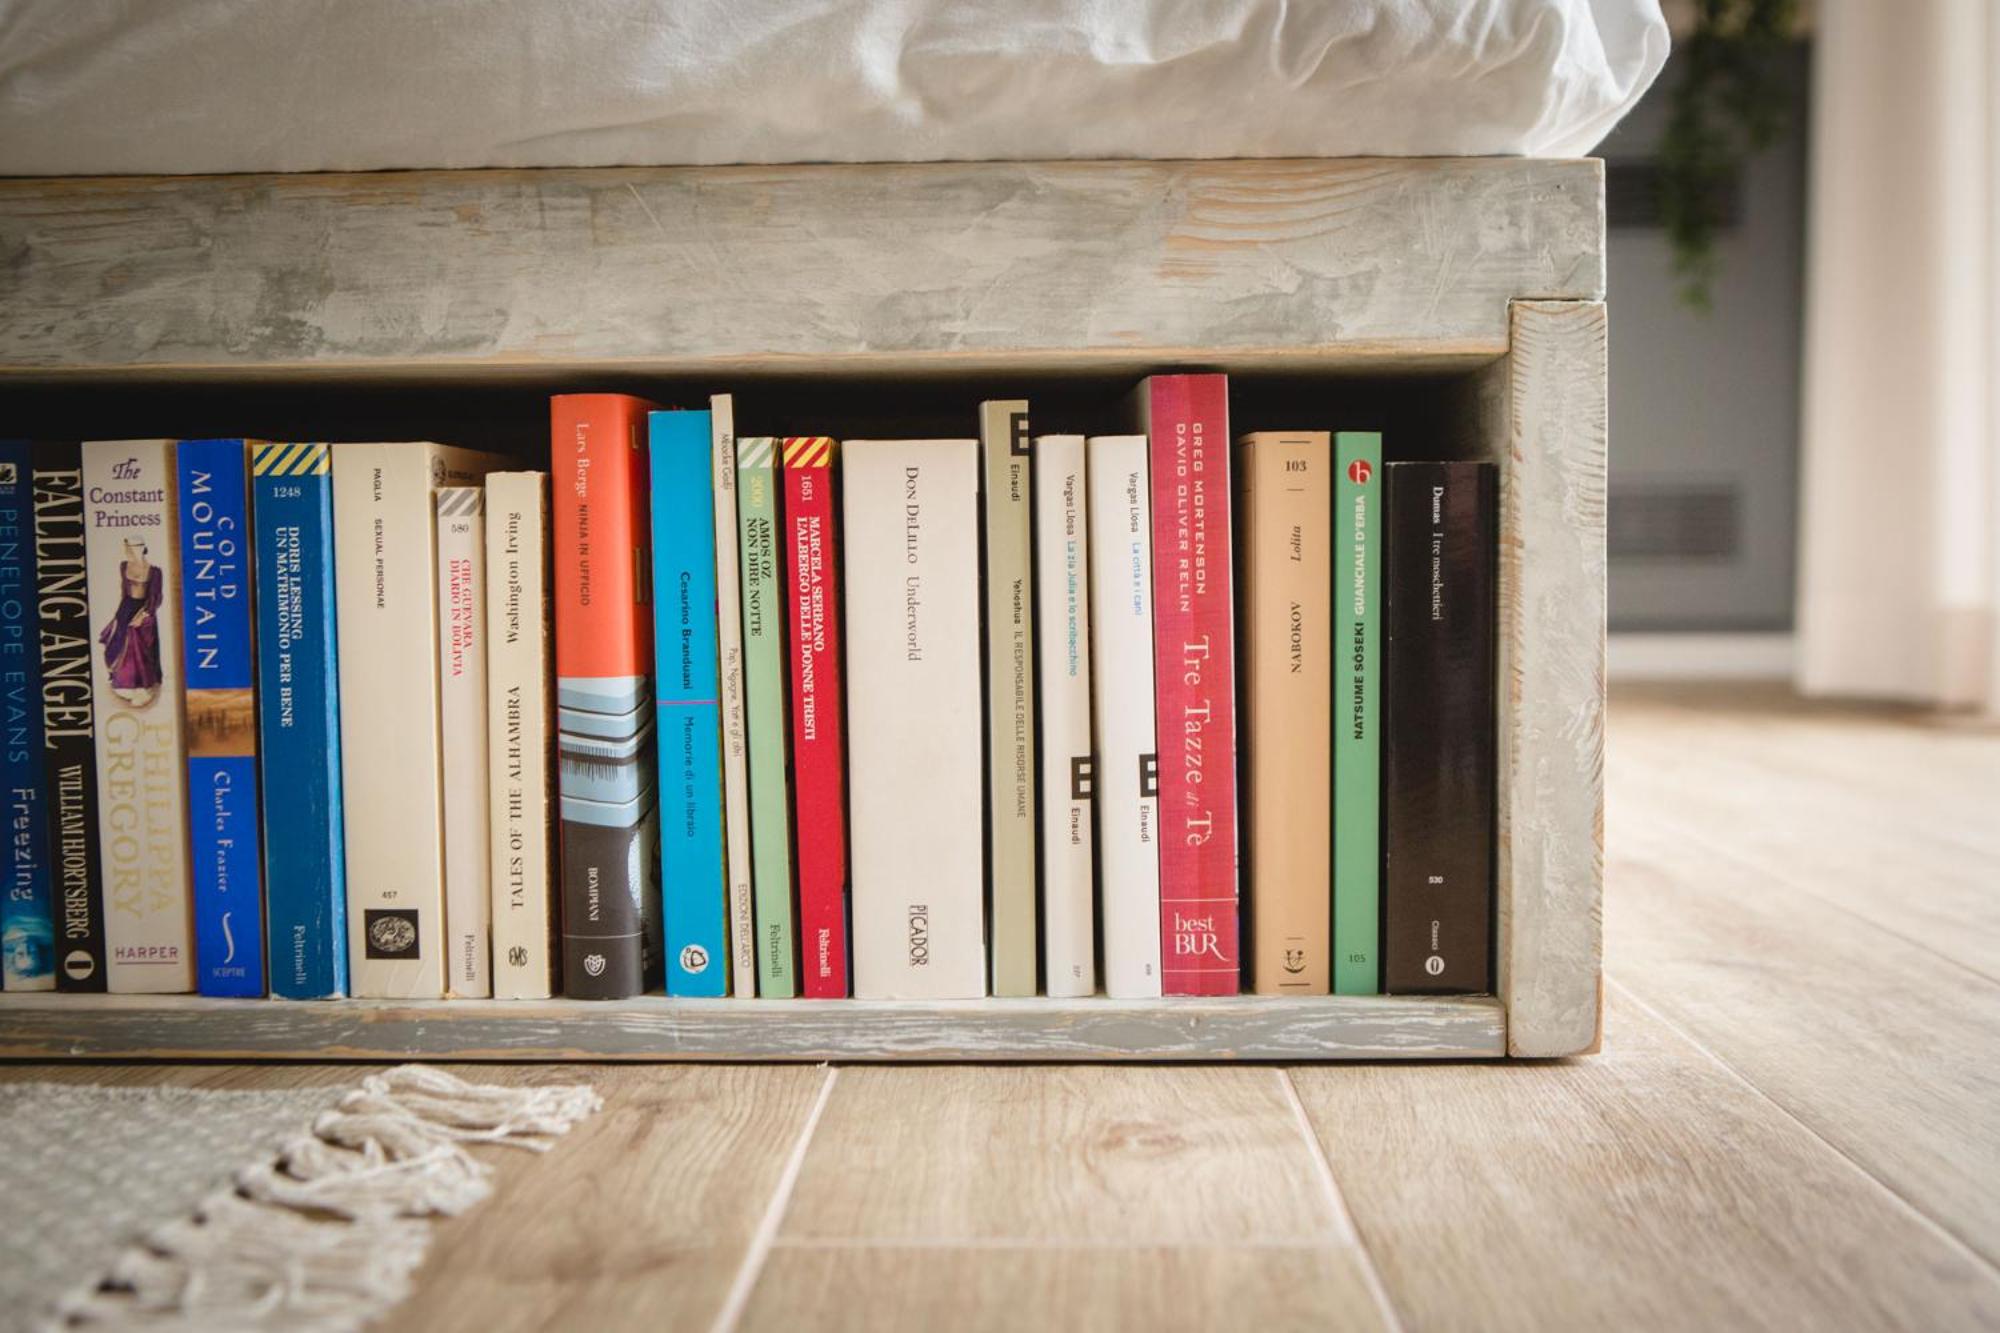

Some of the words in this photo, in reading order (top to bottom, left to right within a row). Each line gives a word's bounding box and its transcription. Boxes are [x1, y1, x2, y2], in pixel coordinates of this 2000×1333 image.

[576, 422, 590, 453] Lars
[1176, 423, 1187, 477] DAVID
[1192, 423, 1203, 472] GREG
[112, 457, 142, 480] The
[373, 467, 382, 502] PAGLIA
[575, 459, 591, 498] Berge
[1010, 464, 1020, 502] Einaudi
[1285, 460, 1307, 472] 103
[89, 487, 164, 504] Constant
[272, 486, 302, 498] 1248
[801, 475, 812, 502] 1651
[1063, 473, 1075, 507] Vargas
[1127, 472, 1139, 505] Vargas
[1432, 486, 1444, 524] Dumas
[94, 510, 162, 528] Princess
[275, 527, 288, 548] UN
[374, 518, 384, 557] SEXUAL
[451, 523, 469, 534] 580
[506, 512, 521, 553] Irving
[577, 504, 588, 539] NINJA
[747, 517, 758, 549] NON
[759, 517, 772, 557] AMOS
[1066, 509, 1076, 536] Llosa
[1131, 508, 1140, 533] Llosa
[1177, 485, 1188, 550] OLIVER
[1193, 480, 1206, 595] MORTENSON
[1355, 495, 1365, 541] D'ERBA
[32, 467, 88, 622] FALLING
[217, 516, 238, 599] COLD
[288, 526, 301, 573] DORIS
[579, 543, 589, 556] IN
[796, 516, 810, 592] L'ALBERGO
[809, 516, 822, 585] MARCELA
[1067, 541, 1077, 554] La
[1068, 555, 1077, 569] zia
[1132, 541, 1142, 554] La
[1290, 525, 1302, 562] Lolita
[1432, 540, 1442, 555] tre
[0, 508, 23, 654] PENELOPE
[190, 469, 219, 670] MOUNTAIN
[376, 558, 385, 609] PERSONAE
[450, 559, 461, 604] DIARIO
[461, 559, 471, 584] CHE
[579, 560, 591, 606] UFFICIO
[748, 551, 760, 586] DIRE
[761, 558, 772, 579] OZ
[1068, 571, 1077, 594] Julia
[1179, 558, 1190, 612] RELIN
[1354, 543, 1365, 615] GUANCIALE
[1432, 557, 1444, 620] moschettieri
[276, 551, 291, 650] MATRIMONIO
[289, 576, 303, 640] LESSING
[451, 607, 461, 620] IN
[462, 587, 472, 649] GUEVARA
[506, 561, 522, 644] Washington
[680, 571, 692, 625] Cesarino
[750, 589, 762, 637] NOTTE
[799, 594, 812, 641] DELLE
[811, 587, 824, 652] SERRANO
[906, 576, 921, 661] Underworld
[1013, 579, 1023, 625] Yehoshua
[1068, 604, 1077, 614] lo
[1135, 595, 1144, 616] cani
[452, 622, 462, 677] BOLIVIA
[1014, 631, 1023, 639] IL
[1068, 615, 1077, 677] scribacchino
[1291, 601, 1302, 673] NABOKOV
[279, 653, 292, 683] PER
[682, 628, 694, 690] Branduani
[802, 643, 815, 693] DONNE
[1014, 641, 1025, 711] RESPONSABILE
[1184, 634, 1210, 685] Tre
[40, 628, 94, 750] ANGEL
[280, 687, 293, 728] BENE
[1354, 675, 1365, 740] NATSUME
[5, 670, 30, 763] EVANS
[507, 685, 522, 781] ALHAMBRA
[803, 695, 816, 741] TRISTI
[1015, 712, 1025, 742] DELLE
[684, 716, 695, 767] Memorie
[1184, 699, 1211, 784] Tazze
[684, 768, 695, 783] di
[1016, 744, 1026, 783] RISORSE
[59, 764, 84, 838] WILLIAM
[213, 770, 233, 832] Charles
[509, 787, 523, 819] THE
[686, 785, 695, 799] un
[1017, 785, 1026, 818] UMANE
[1186, 791, 1199, 807] di
[105, 711, 143, 919] GREGORY
[141, 720, 175, 912] PHILIPPA
[687, 802, 699, 838] libraio
[1072, 806, 1081, 845] Einaudi
[1140, 805, 1150, 843] Einaudi
[1186, 810, 1212, 846] Tè
[10, 788, 35, 901] Freezing
[510, 829, 523, 850] OF
[216, 838, 233, 892] Frazier
[511, 857, 524, 911] TALES
[62, 839, 90, 940] HJORTSBERG
[587, 867, 599, 921] BOMPIANI
[738, 883, 748, 921] EDIZIONI
[910, 905, 928, 966] PICADOR
[1174, 912, 1215, 932] best
[115, 947, 178, 959] HARPER
[293, 925, 307, 985] Feltrinelli
[465, 934, 475, 982] Feltrinelli
[770, 924, 782, 978] Feltrinelli
[818, 928, 831, 978] Feltrinelli
[1175, 932, 1230, 962] BUR
[1349, 953, 1366, 963] 105
[212, 967, 246, 978] SCEPTRE
